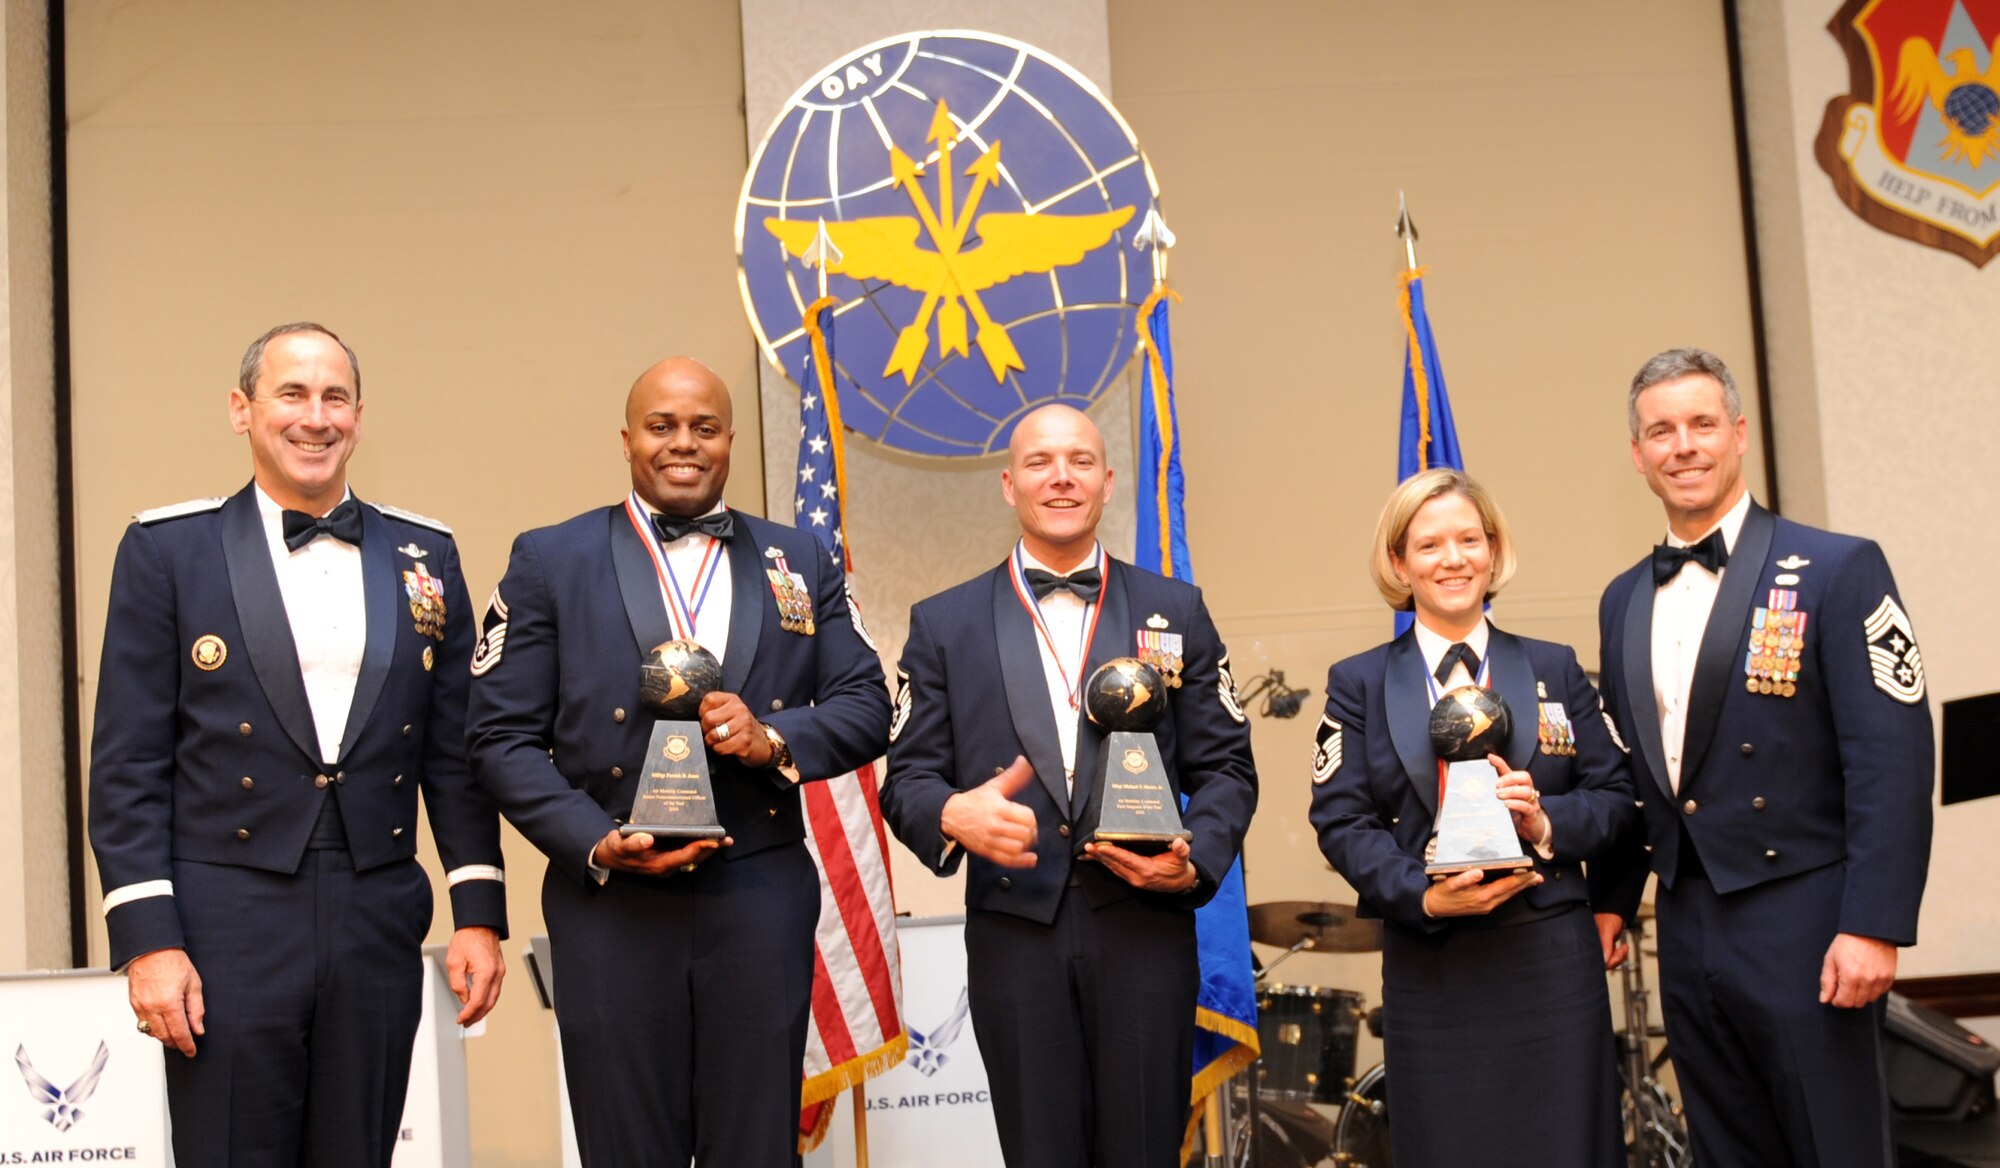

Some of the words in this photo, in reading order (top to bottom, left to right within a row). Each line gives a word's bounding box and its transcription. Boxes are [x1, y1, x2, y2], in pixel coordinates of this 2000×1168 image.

[821, 53, 883, 100] OAY
[1878, 169, 1932, 205] HELP
[1935, 195, 1997, 229] FROM
[898, 1095, 930, 1108] AIR
[935, 1090, 989, 1106] FORC
[31, 1150, 63, 1163] AIR
[68, 1147, 136, 1161] FORCE
